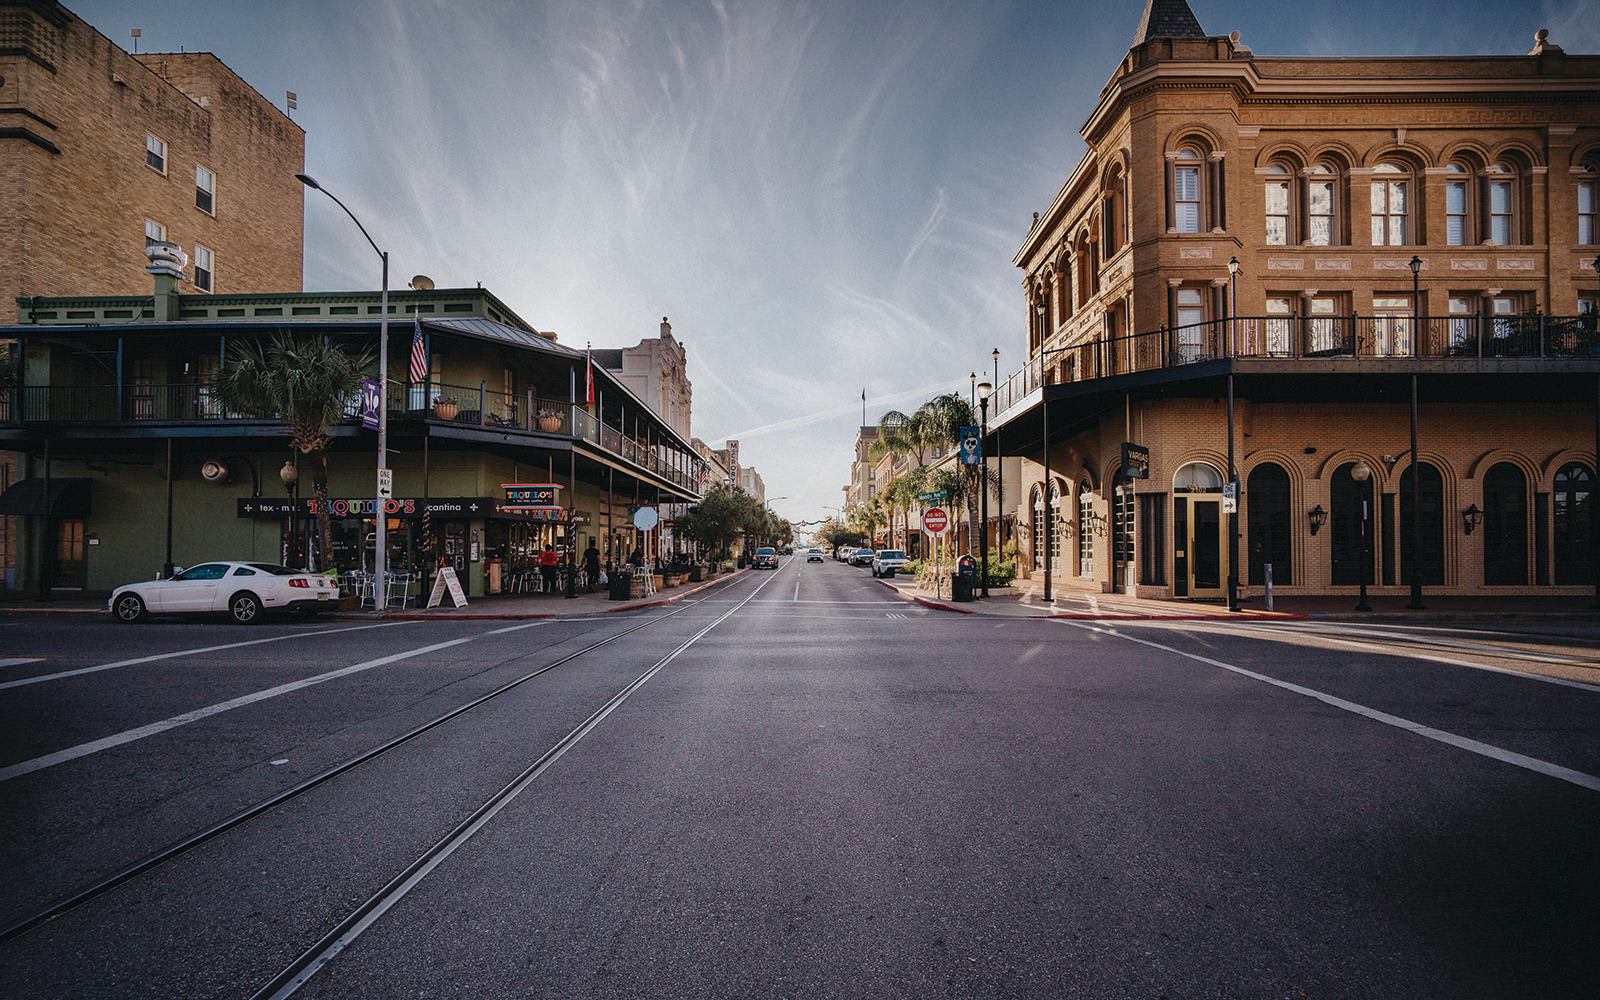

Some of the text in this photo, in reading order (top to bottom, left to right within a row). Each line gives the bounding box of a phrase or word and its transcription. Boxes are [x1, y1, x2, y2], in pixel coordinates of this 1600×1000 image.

[1128, 450, 1148, 462] VARGAS
[380, 470, 390, 478] ONE
[507, 491, 553, 500] TAQUILO'S
[260, 504, 273, 512] tex
[429, 503, 461, 511] cantina
